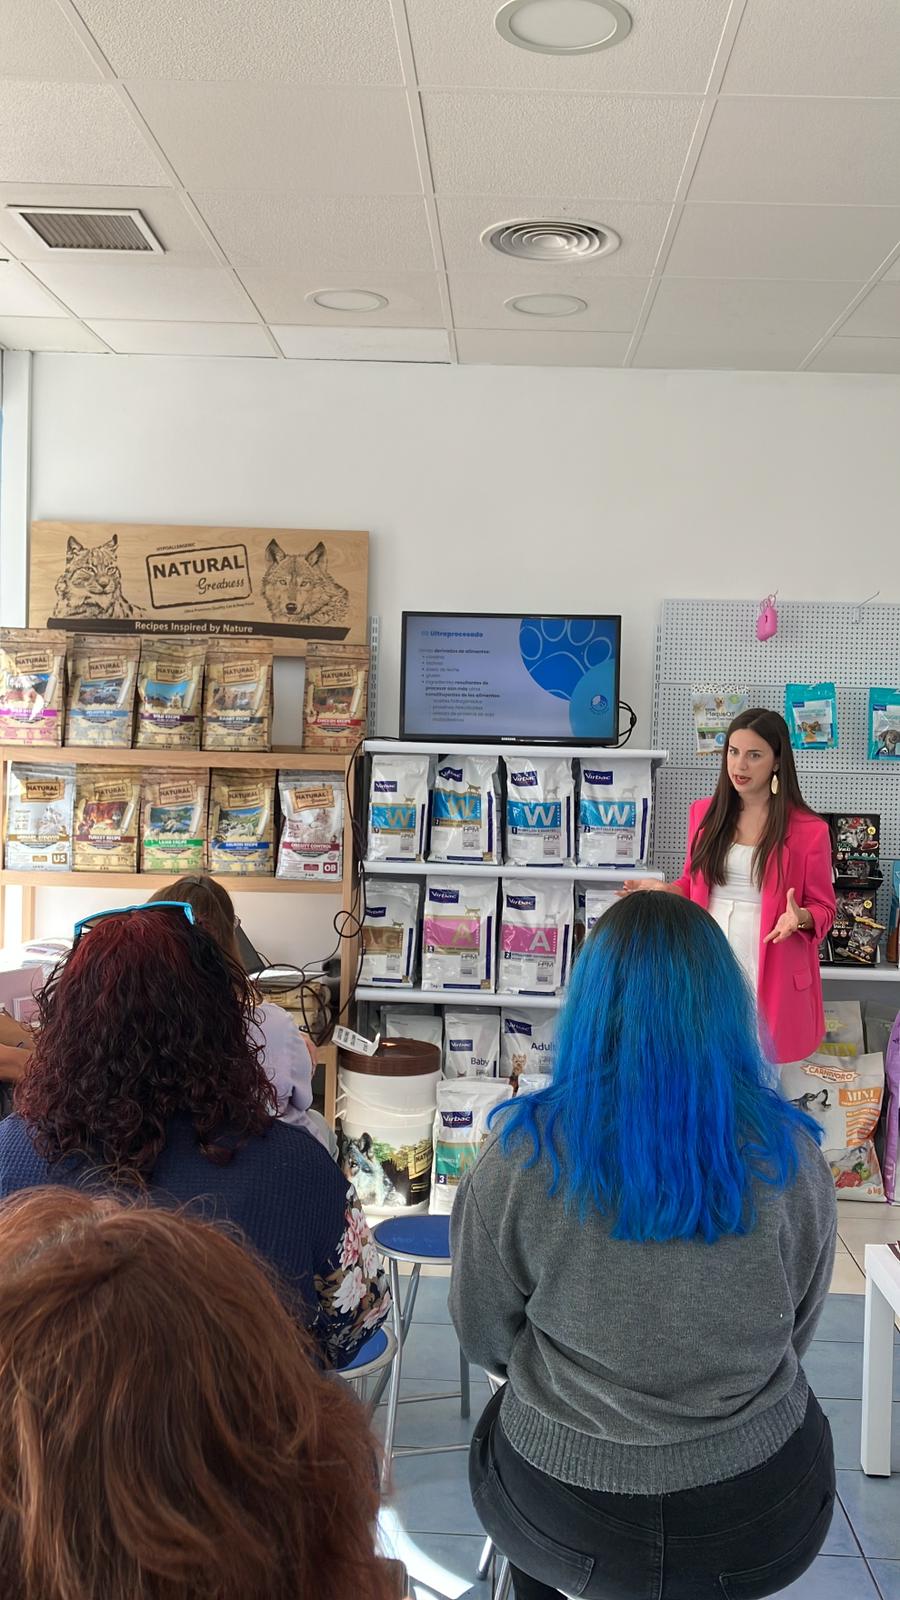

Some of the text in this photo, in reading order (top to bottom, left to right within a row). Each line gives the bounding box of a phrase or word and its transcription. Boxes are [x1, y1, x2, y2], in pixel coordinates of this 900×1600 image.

[152, 555, 245, 579] NATURAL
[197, 577, 244, 595] Greatness
[135, 621, 253, 633] Recipes Inspired by Nature
[16, 656, 47, 665] NATURAL
[91, 662, 120, 671] NATURAL
[224, 667, 253, 676] NATURAL
[322, 671, 351, 679] NATURAL
[585, 773, 611, 781] Virbac
[160, 788, 191, 796] NATURAL
[229, 791, 258, 799] NATURAL
[296, 792, 326, 800] NATURAL
[448, 798, 474, 816] W
[387, 809, 411, 827] W
[524, 805, 555, 826] W
[599, 804, 630, 825] W
[53, 854, 66, 863] US
[324, 864, 336, 872] OB
[431, 891, 456, 899] Virbac
[508, 897, 533, 906] Virbac
[452, 922, 473, 945] A
[529, 931, 551, 952] A
[531, 1042, 554, 1051] Adul
[470, 1057, 489, 1067] Baby
[808, 1066, 853, 1080] CARNIVORO
[847, 1089, 875, 1102] MINI
[443, 1115, 471, 1123] Virbac
[439, 1175, 445, 1183] 3
[873, 1187, 881, 1195] kg
